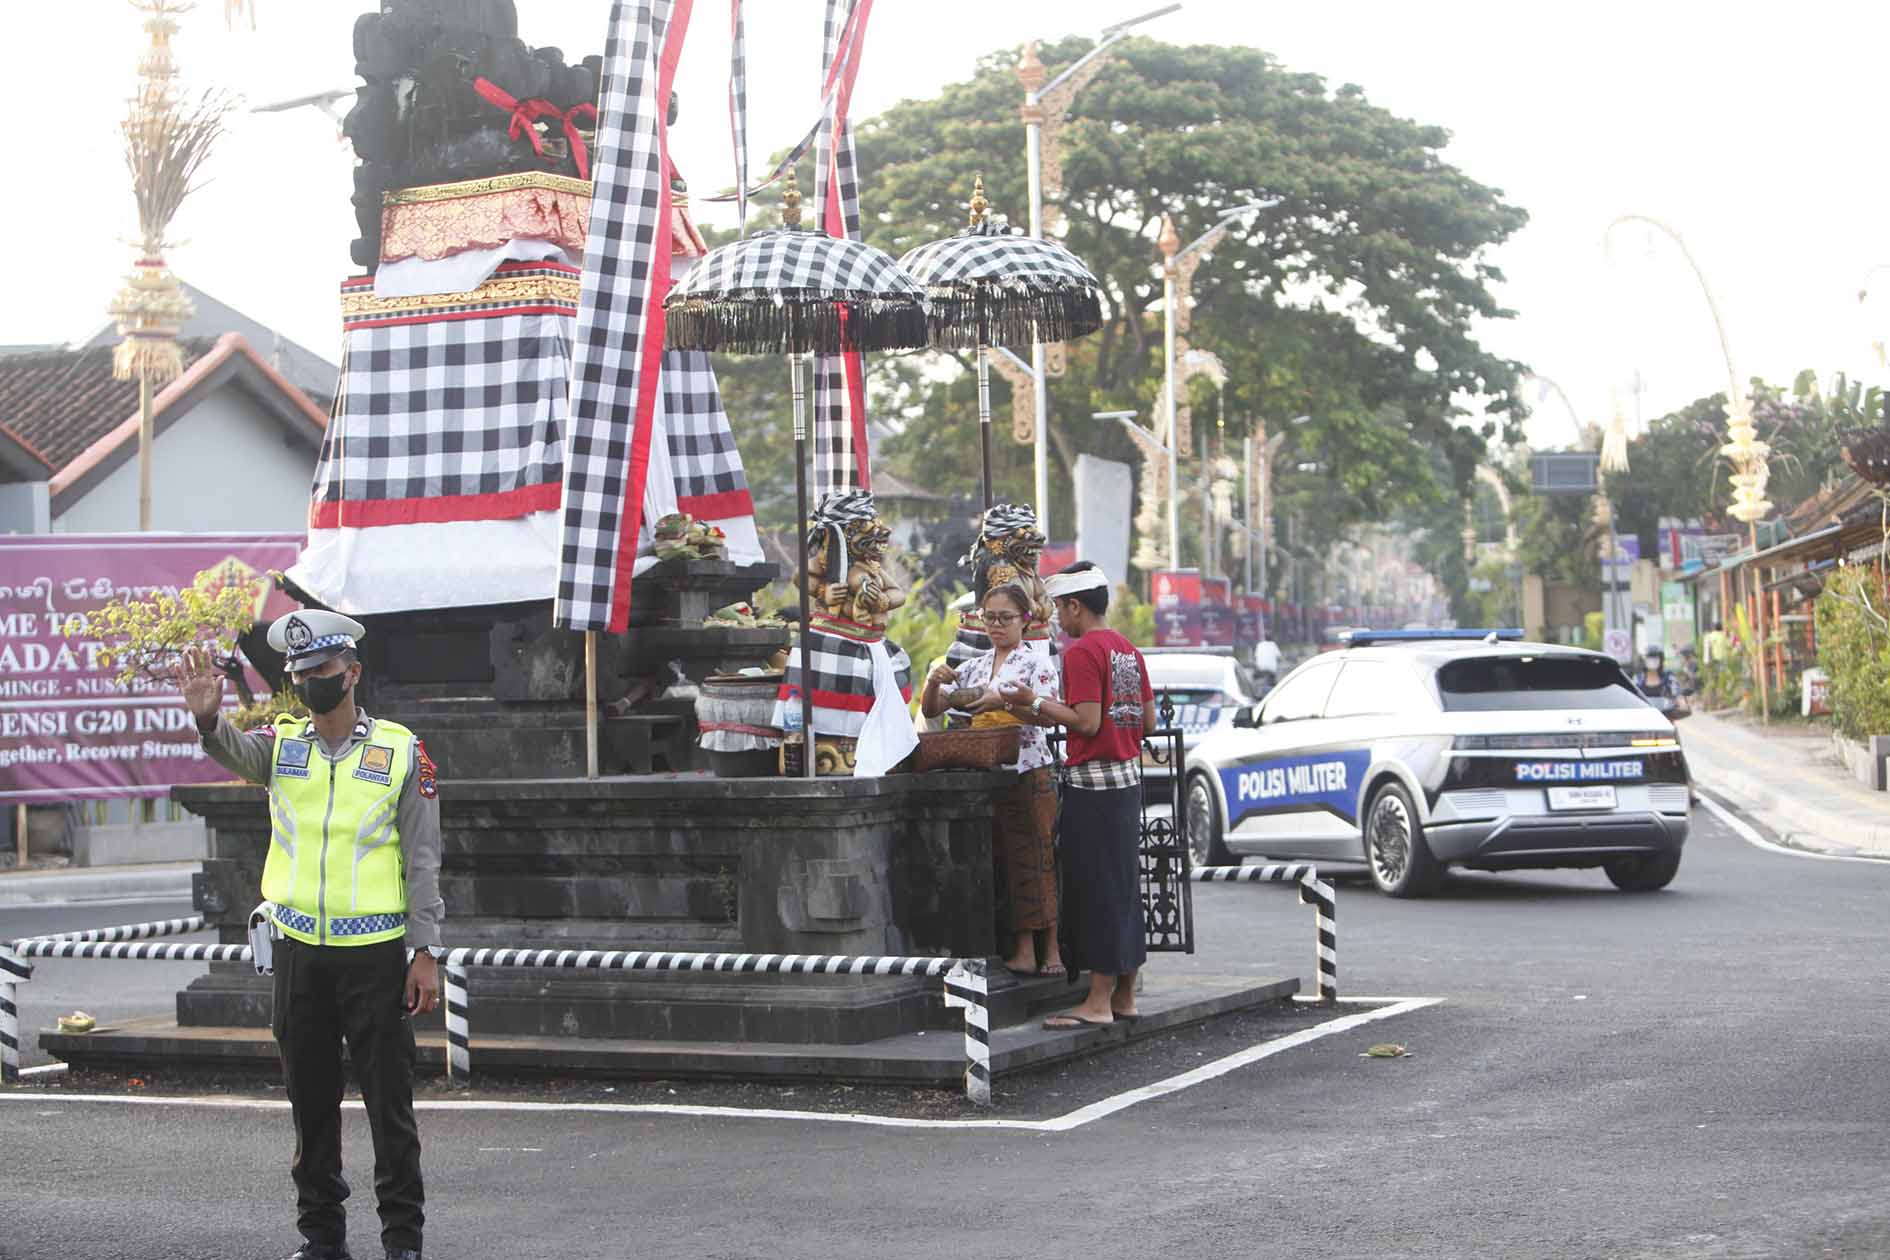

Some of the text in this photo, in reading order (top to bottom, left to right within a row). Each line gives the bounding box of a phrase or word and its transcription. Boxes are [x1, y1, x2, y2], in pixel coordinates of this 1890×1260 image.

[45, 611, 89, 636] TO
[0, 641, 104, 673] ADAT
[75, 677, 129, 694] NUSA
[0, 711, 69, 737] ENSI
[75, 709, 128, 734] G20
[65, 742, 139, 761] Recover
[1238, 761, 1347, 801] POLISI MILITER
[1516, 761, 1643, 780] POLISI MILITER
